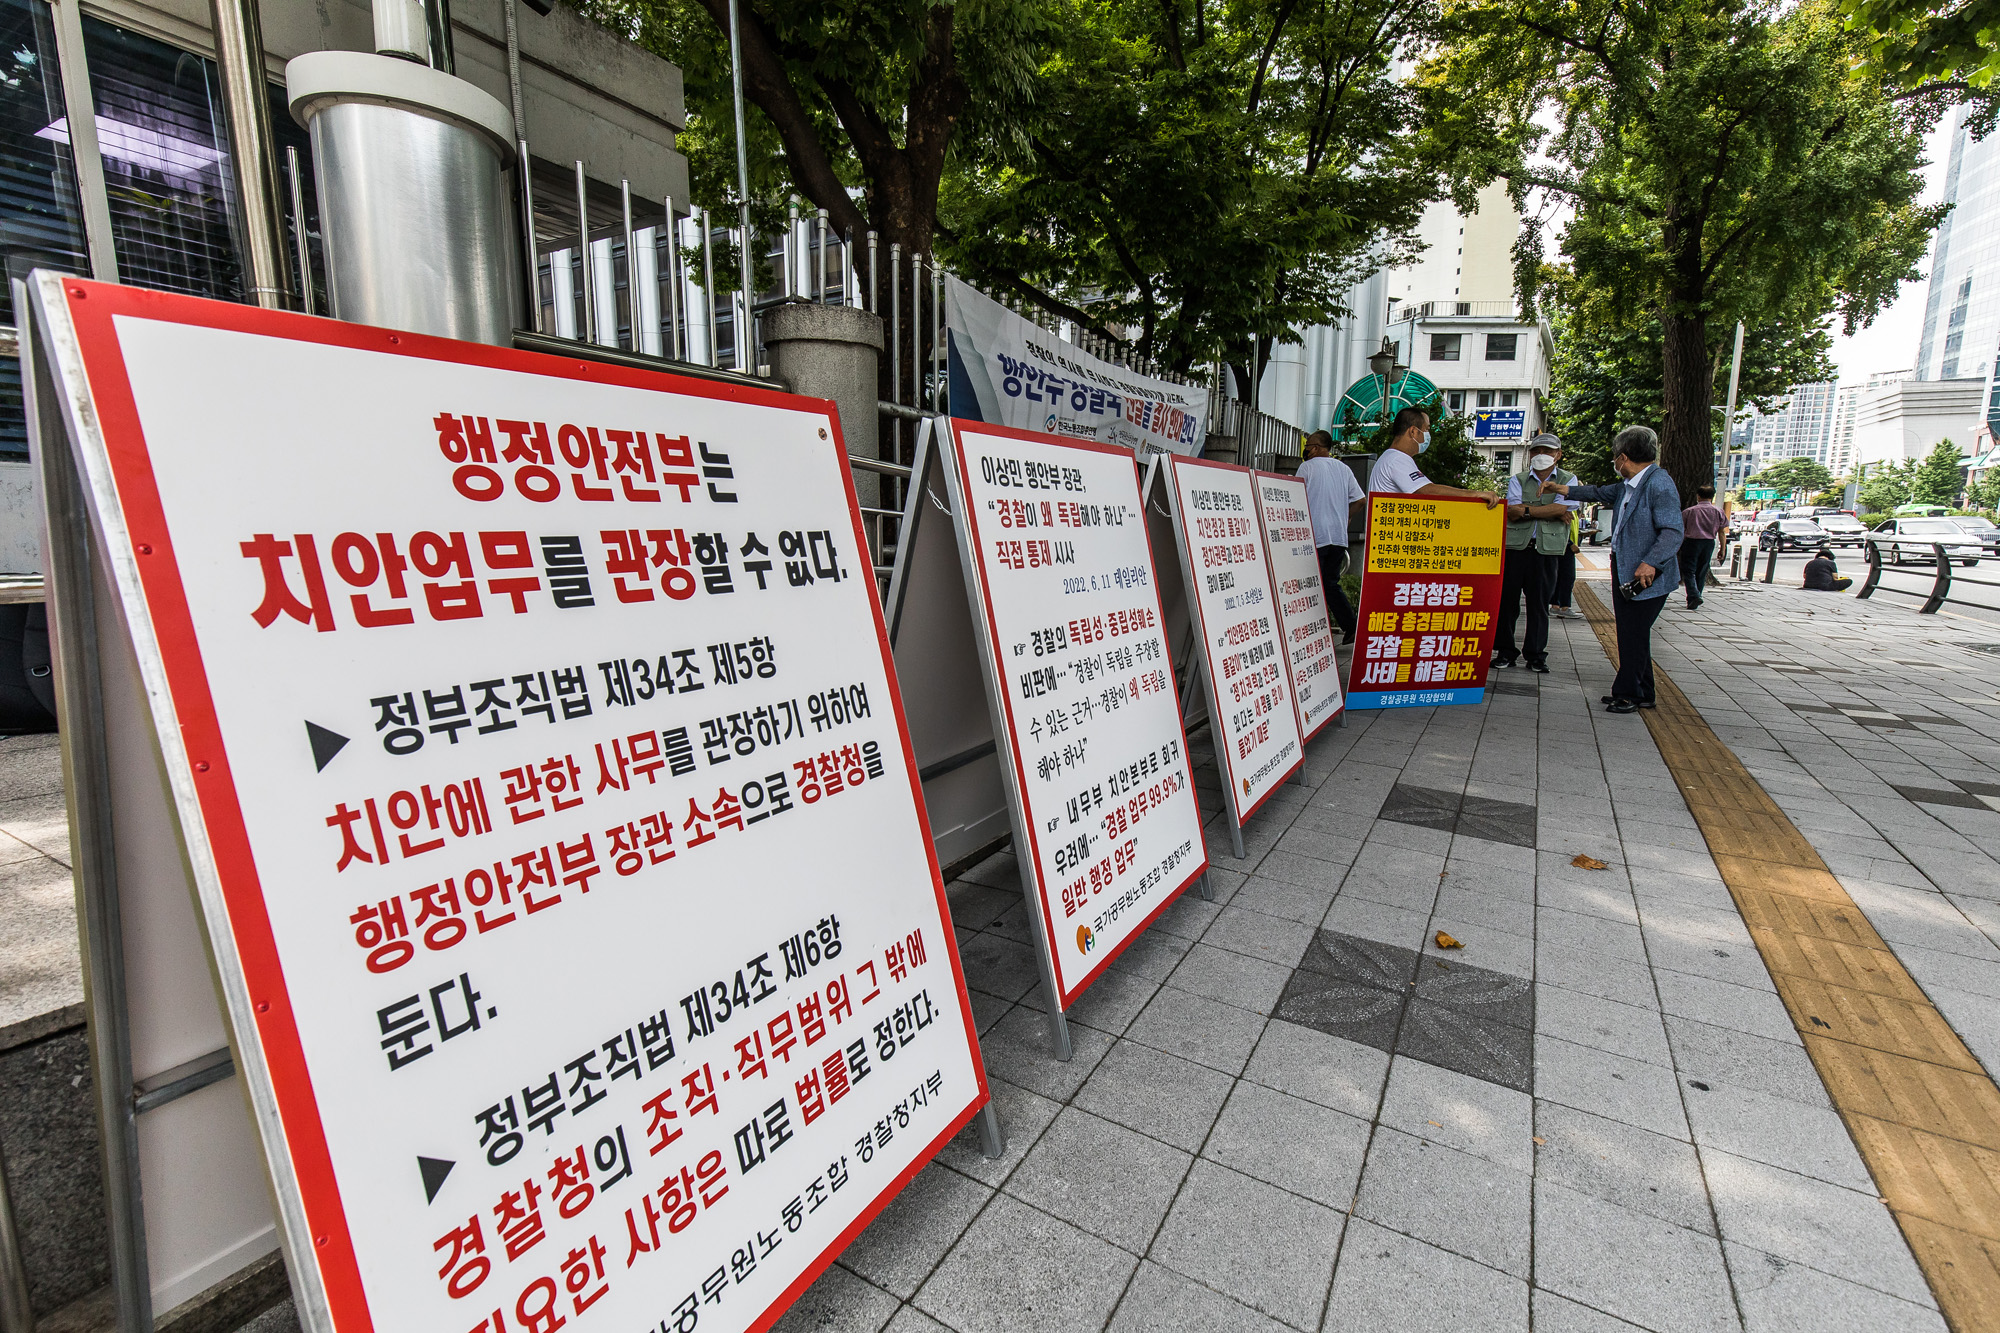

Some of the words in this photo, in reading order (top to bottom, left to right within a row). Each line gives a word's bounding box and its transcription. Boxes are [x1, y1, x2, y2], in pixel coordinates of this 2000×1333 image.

[1025, 340, 1059, 368] 경찰의
[997, 352, 1065, 406] 행안부
[1151, 401, 1172, 437] 결사
[1166, 407, 1197, 446] 반대한다
[432, 412, 738, 503] 행정안전부는
[981, 455, 1023, 487] 이상민
[1024, 460, 1060, 490] 행안부
[1061, 467, 1086, 492] 장관,
[1040, 500, 1053, 527] 왜
[1057, 501, 1100, 527] 독립해야
[1191, 489, 1212, 510] 이상민
[1211, 491, 1230, 510] 행안부
[1380, 502, 1395, 513] 경찰
[1397, 502, 1419, 514] 장악의
[1420, 503, 1436, 515] 시작
[1196, 517, 1225, 538] 치안정감
[1378, 529, 1393, 540] 참석
[1395, 530, 1403, 541] 시
[1404, 530, 1433, 542] 감찰조사
[1379, 515, 1394, 526] 회의
[1396, 516, 1411, 527] 개최
[1412, 517, 1420, 527] 시
[1421, 517, 1450, 529] 대기발령
[995, 540, 1024, 569] 직접
[1026, 539, 1052, 568] 통제
[1054, 540, 1074, 564] 시사
[1201, 545, 1232, 568] 정치권력과
[1231, 544, 1244, 563] 연관
[1243, 543, 1256, 560] 세평
[1376, 557, 1406, 568] 행안부의
[1408, 558, 1429, 569] 경찰국
[1431, 558, 1445, 569] 신설
[1447, 559, 1461, 569] 반대
[1377, 543, 1400, 554] 민주화
[1401, 544, 1431, 555] 역행하는
[1432, 545, 1453, 556] 경찰국
[1455, 546, 1469, 556] 신설
[1470, 546, 1499, 557] 철회하라!
[239, 530, 595, 632] 치안업무를
[599, 528, 734, 603] 관장할
[739, 531, 772, 590] 수
[777, 529, 847, 586] 없다.
[1113, 565, 1147, 588] 데일리안
[1206, 573, 1219, 593] 많이
[1217, 571, 1234, 591] 들었다
[1393, 581, 1473, 606] 경찰청장은
[1258, 616, 1269, 634] 전원
[1367, 611, 1399, 631] 해당
[1401, 611, 1459, 631] 총경들에
[1461, 610, 1490, 630] 대한
[1030, 625, 1067, 656] 경찰의
[1105, 646, 1133, 672] 독립을
[1134, 637, 1160, 663] 주장할
[1262, 639, 1274, 657] 대해
[1365, 634, 1415, 658] 감찰을
[1418, 635, 1481, 657] 중지하고,
[1360, 661, 1411, 683] 사태를
[1413, 660, 1476, 682] 해결하라.
[370, 665, 592, 755] 정부조직법
[597, 648, 704, 707] 제34조
[706, 635, 776, 684] 제5항
[1030, 717, 1042, 743] 수
[1045, 708, 1068, 737] 있는
[1128, 676, 1139, 699] 왜
[1140, 669, 1166, 694] 독립을
[1380, 693, 1416, 705] 경찰공무원
[1418, 692, 1453, 702] 직장협의회
[1233, 707, 1254, 733] 있다는
[1237, 729, 1257, 759] 들었기
[325, 777, 492, 872] 치안에
[499, 754, 583, 824] 관한
[594, 726, 696, 795] 사무를
[698, 698, 804, 765] 관장하기
[807, 682, 871, 732] 위하여
[1036, 751, 1061, 781] 해야
[1066, 783, 1103, 824] 내무부
[1108, 751, 1158, 797] 치안본부로
[1161, 739, 1179, 765] 회귀
[1128, 791, 1148, 824] 업무
[1148, 769, 1184, 808] 99.9%가
[349, 832, 600, 973] 행정안전부
[605, 810, 675, 876] 장관
[682, 771, 793, 848] 소속으로
[792, 740, 884, 804] 경찰청을
[1061, 875, 1087, 918] 일반
[1088, 856, 1112, 894] 행정
[1093, 866, 1160, 932] 국가공무원노동조합
[1161, 839, 1191, 874] 경찰청지부
[376, 972, 497, 1071] 둔다.
[474, 1008, 675, 1166] 정부조직법
[679, 952, 777, 1043] 제34조
[778, 913, 841, 982] 제6항
[432, 1124, 632, 1299] 경찰청의
[641, 973, 852, 1156] 조직·직무범위
[856, 959, 880, 1005] 그
[884, 927, 926, 983] 밖에
[468, 1234, 609, 1333] 요한
[624, 1149, 729, 1268] 사항은
[733, 1097, 793, 1175] 따로
[794, 1036, 871, 1126] 법률로
[872, 988, 939, 1061] 정한다.
[659, 1155, 848, 1333] 공무원노동조합
[854, 1069, 942, 1163] 경찰청지부
